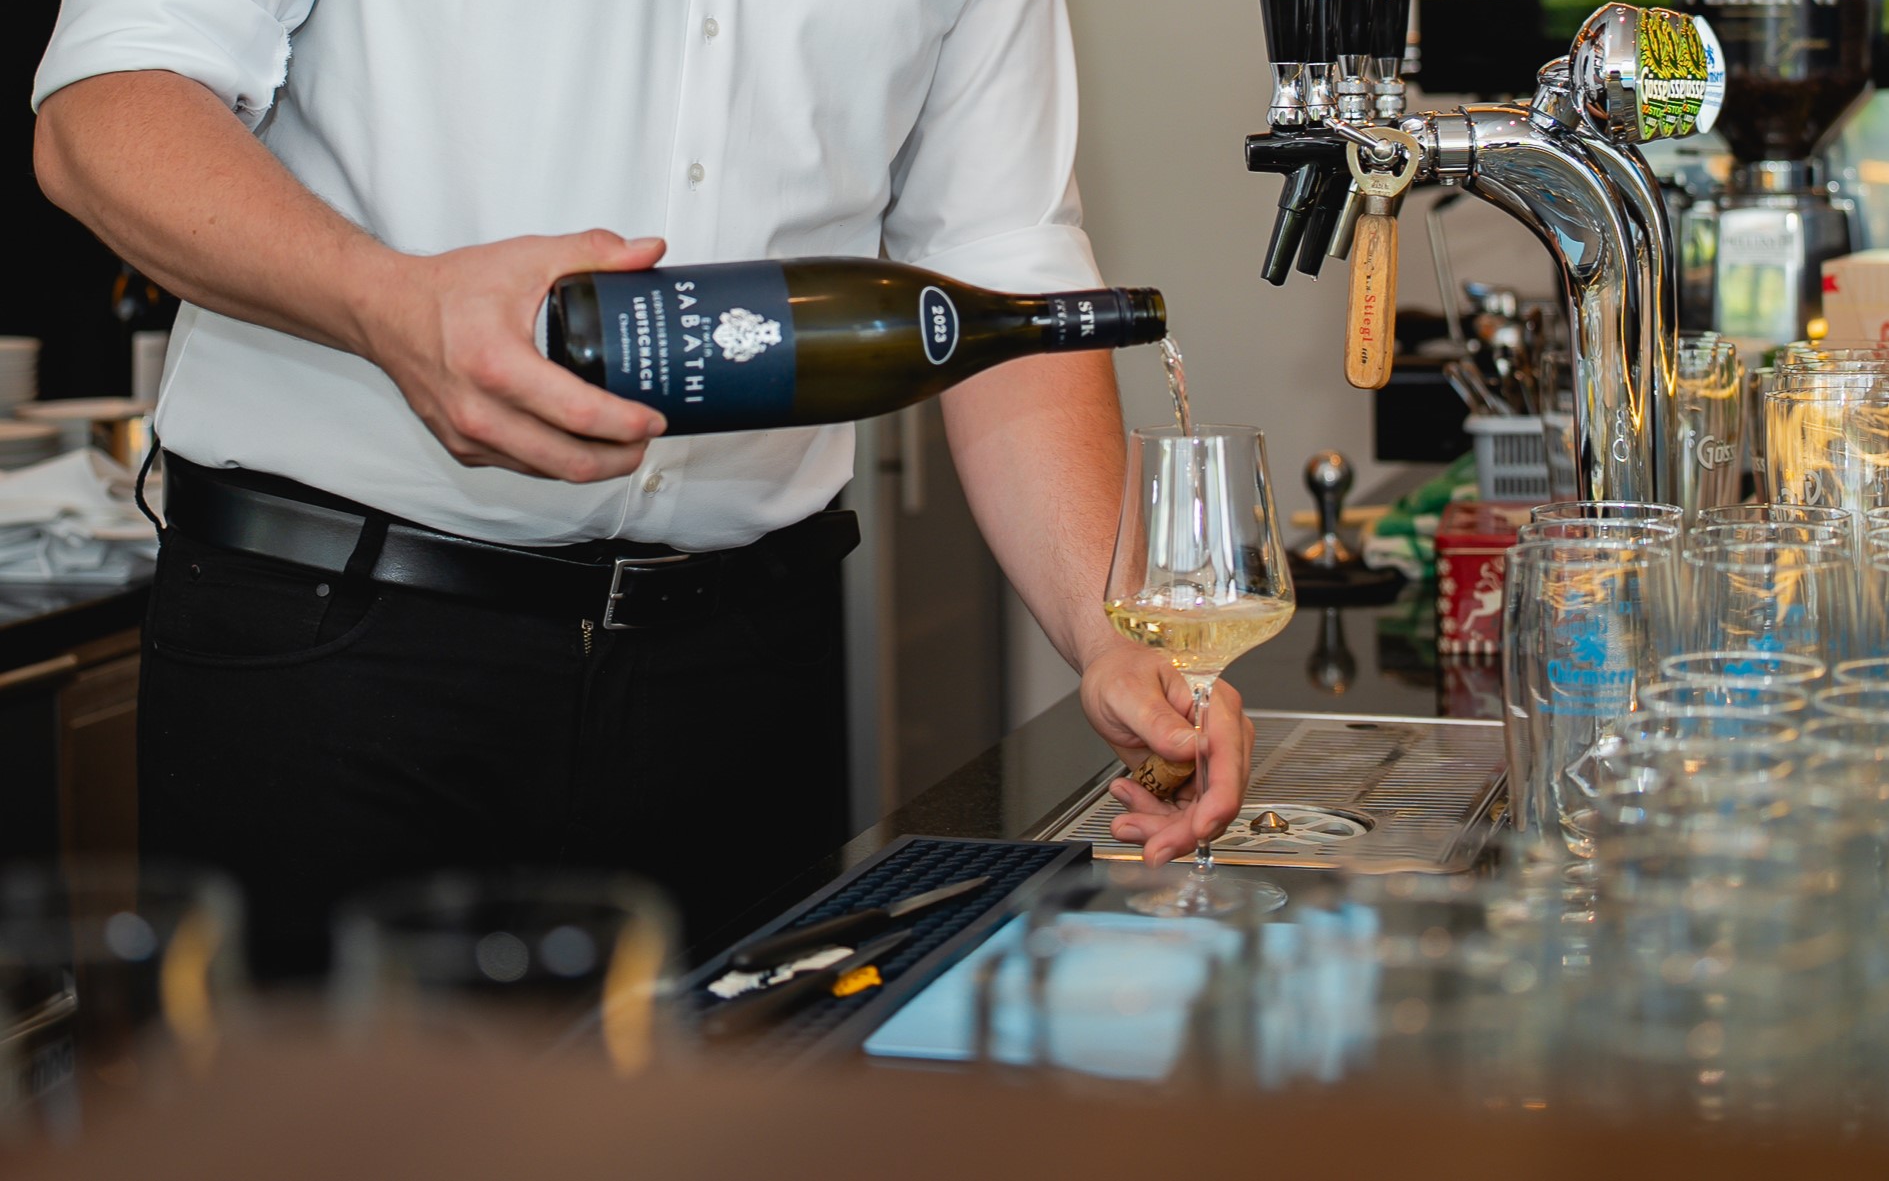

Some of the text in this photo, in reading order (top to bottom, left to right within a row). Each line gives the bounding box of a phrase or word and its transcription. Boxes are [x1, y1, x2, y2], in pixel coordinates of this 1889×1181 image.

[701, 317, 714, 358] Erwin
[931, 305, 948, 344] 2023
[1077, 300, 1095, 338] STK
[1359, 294, 1377, 342] Stiegl
[632, 296, 653, 391] LEUTSCHACH
[675, 281, 705, 403] SABATHI
